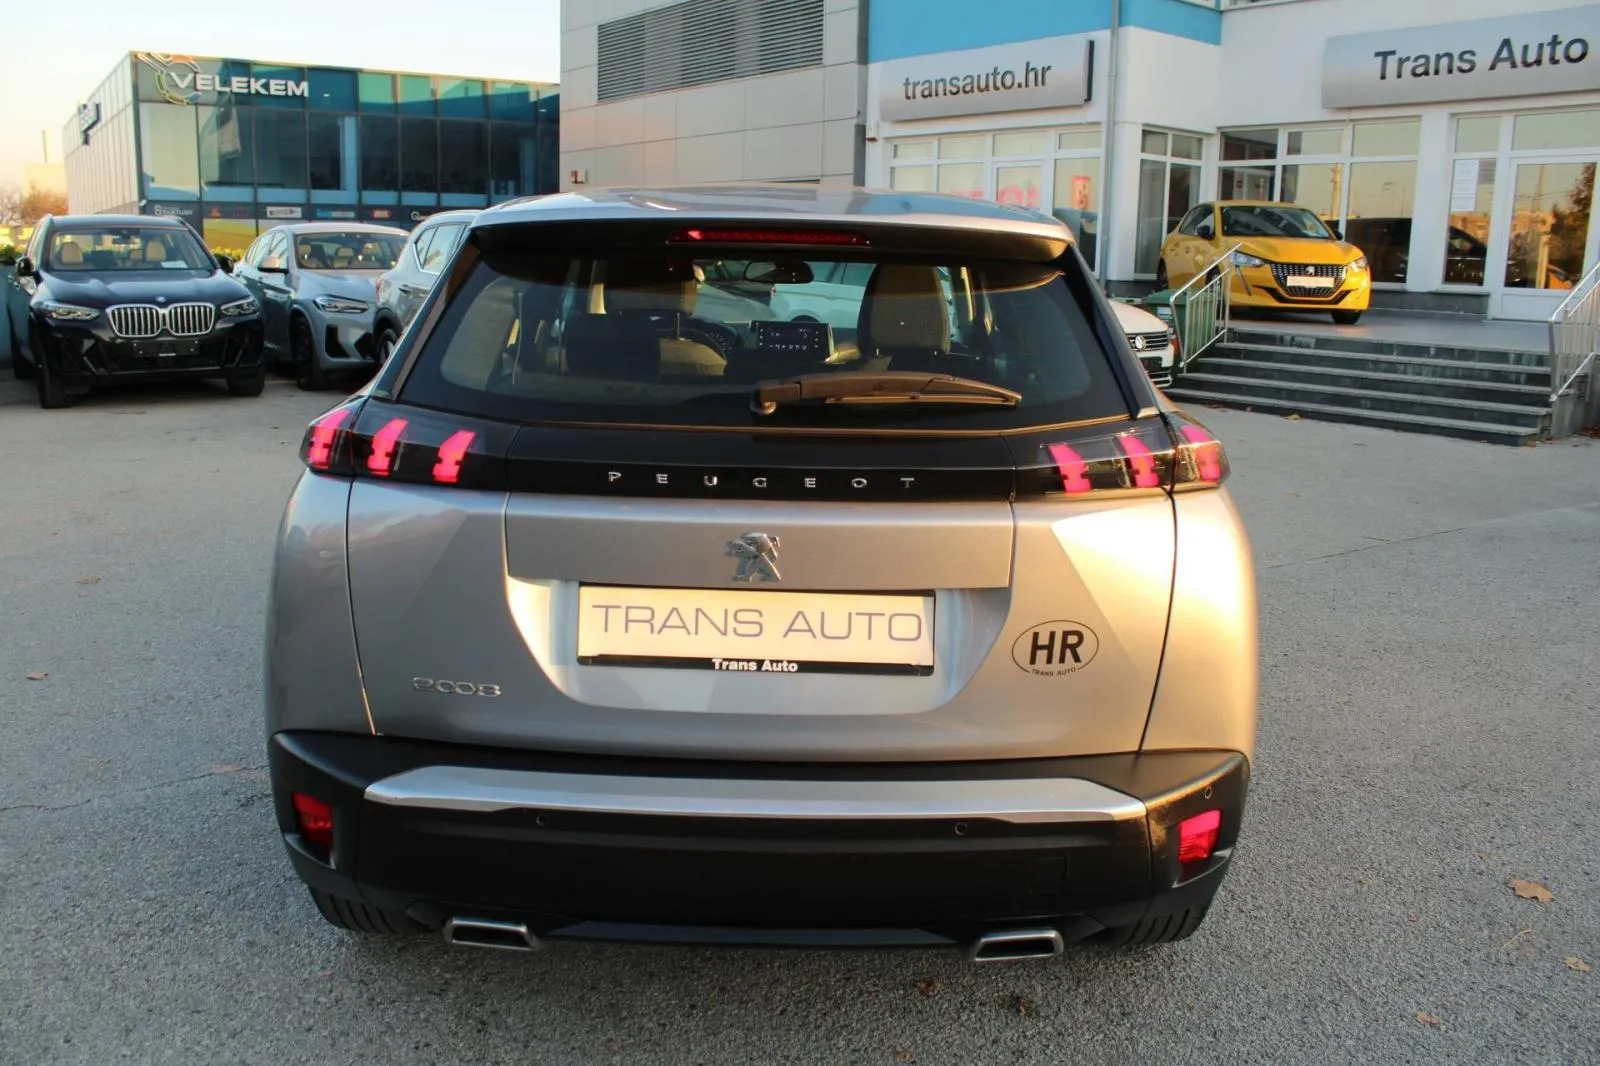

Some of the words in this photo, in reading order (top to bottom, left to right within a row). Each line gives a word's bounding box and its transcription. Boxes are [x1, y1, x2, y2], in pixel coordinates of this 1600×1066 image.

[1374, 49, 1476, 80] Trans
[1488, 34, 1589, 71] Auto
[169, 72, 309, 97] VELEKEM
[903, 61, 1052, 100] transauto.hr
[608, 471, 914, 489] PEUGEOT
[592, 604, 764, 638] TRANS
[783, 610, 922, 642] AUTO
[1029, 629, 1084, 665] HR
[712, 658, 757, 672] Trans
[761, 660, 798, 672] Auto
[1031, 668, 1053, 677] TRANS
[1057, 667, 1076, 676] AUTO
[413, 677, 501, 697] 2008
